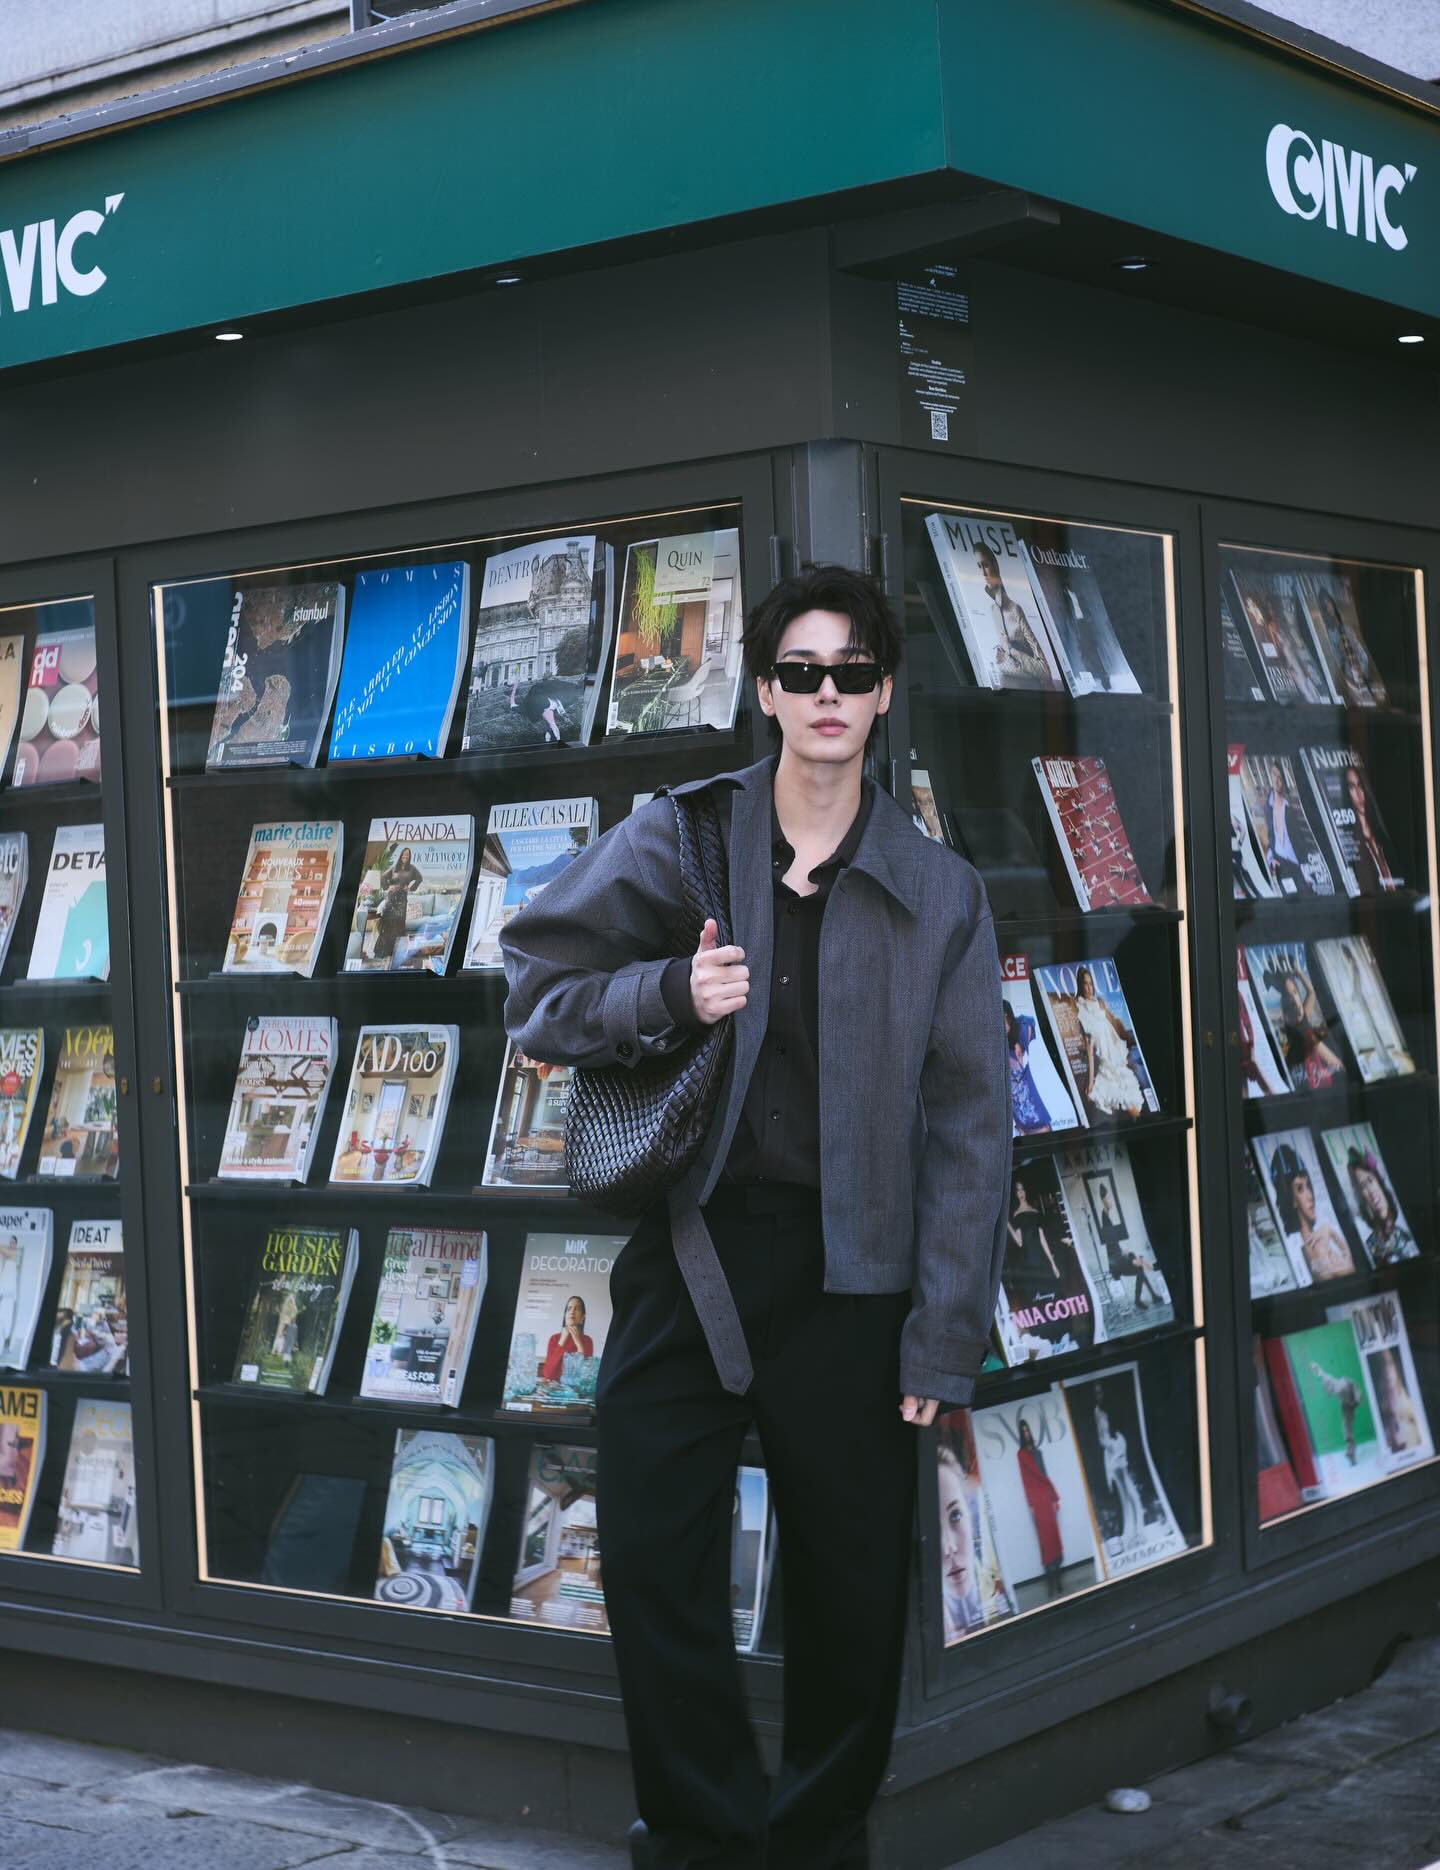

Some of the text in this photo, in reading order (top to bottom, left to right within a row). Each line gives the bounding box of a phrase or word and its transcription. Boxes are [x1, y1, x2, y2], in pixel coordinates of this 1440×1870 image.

[0, 210, 107, 313] VIC
[943, 520, 1018, 558] MUSE
[667, 550, 703, 572] QUIN
[360, 567, 461, 586] NOMAS
[293, 602, 328, 622] istanbul
[361, 645, 405, 696] ARRIVED
[428, 583, 458, 623] LISBON
[231, 652, 247, 692] 204
[333, 739, 433, 758] LISBOA
[255, 822, 333, 842] marie claire
[384, 821, 456, 841] VERANDA
[1001, 957, 1027, 978] CE
[247, 1029, 329, 1053] HOMES
[73, 1227, 111, 1243] IDEAT
[262, 1252, 338, 1276] GARDEN
[1011, 1294, 1090, 1329] MIA GOTH
